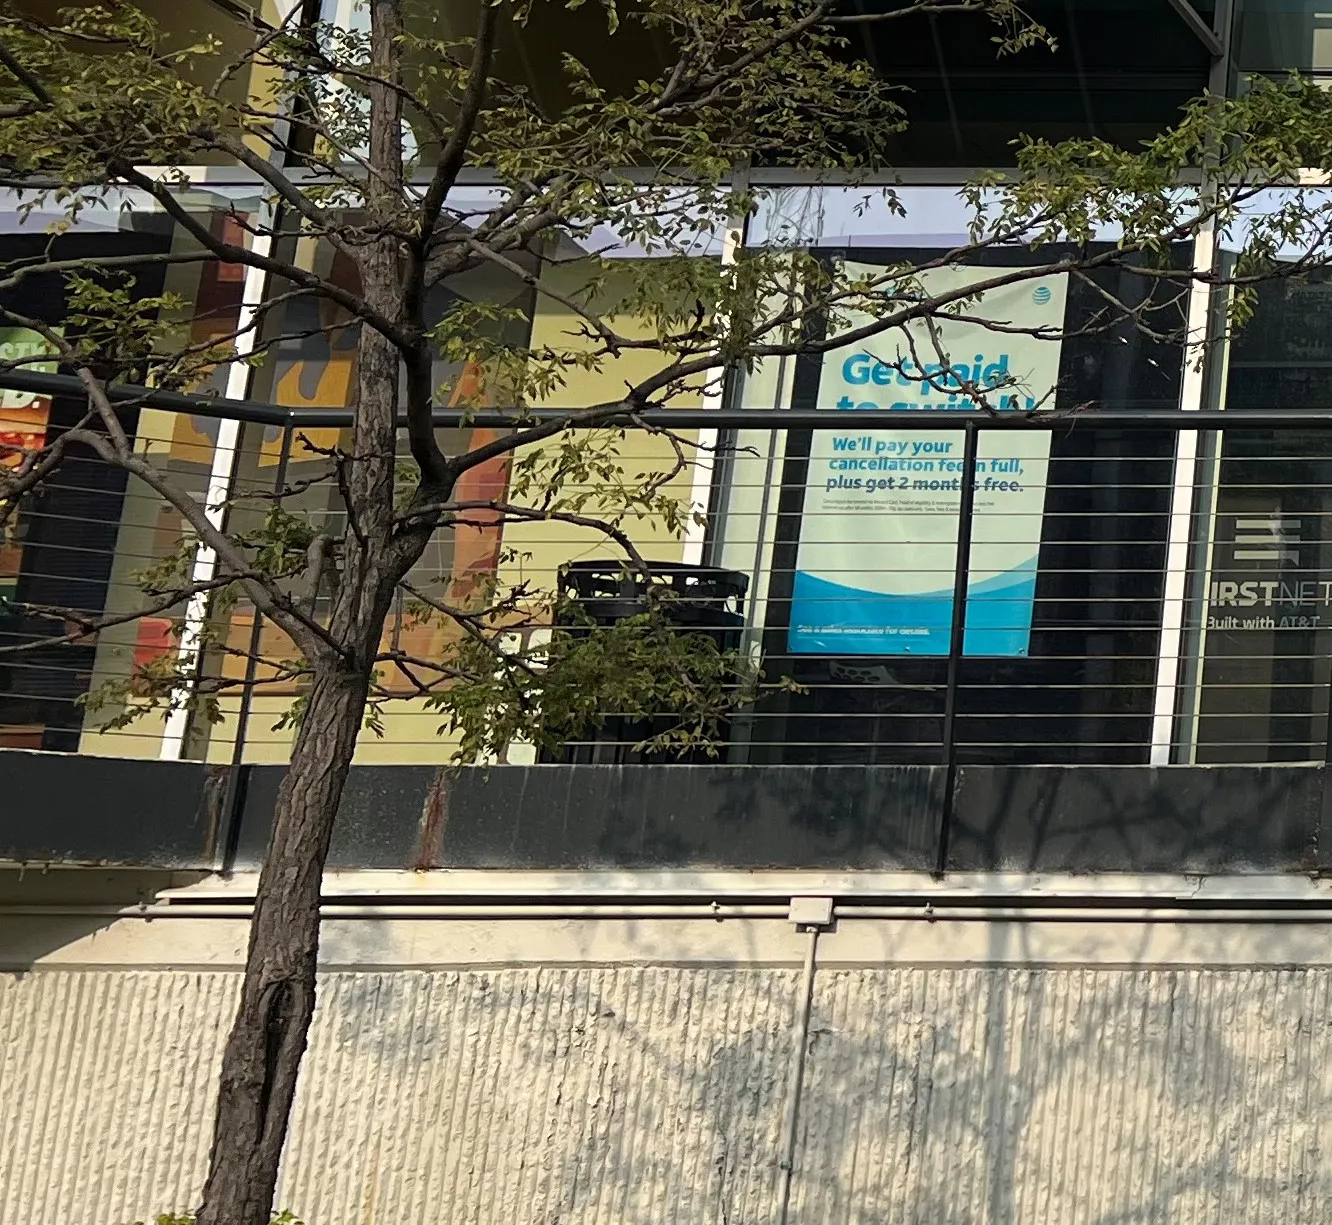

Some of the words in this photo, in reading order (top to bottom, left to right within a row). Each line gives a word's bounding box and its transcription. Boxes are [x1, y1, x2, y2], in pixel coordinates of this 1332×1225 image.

[842, 353, 913, 385] Get
[921, 354, 1009, 396] paid
[875, 440, 907, 455] pay
[912, 441, 953, 456] your
[829, 457, 934, 472] cancellation
[990, 458, 1024, 476] full,
[826, 475, 861, 492] plus
[865, 477, 896, 493] get
[899, 476, 909, 489] 2
[984, 477, 1024, 492] free.
[1243, 616, 1275, 629] with
[1280, 616, 1321, 628] AT&T
